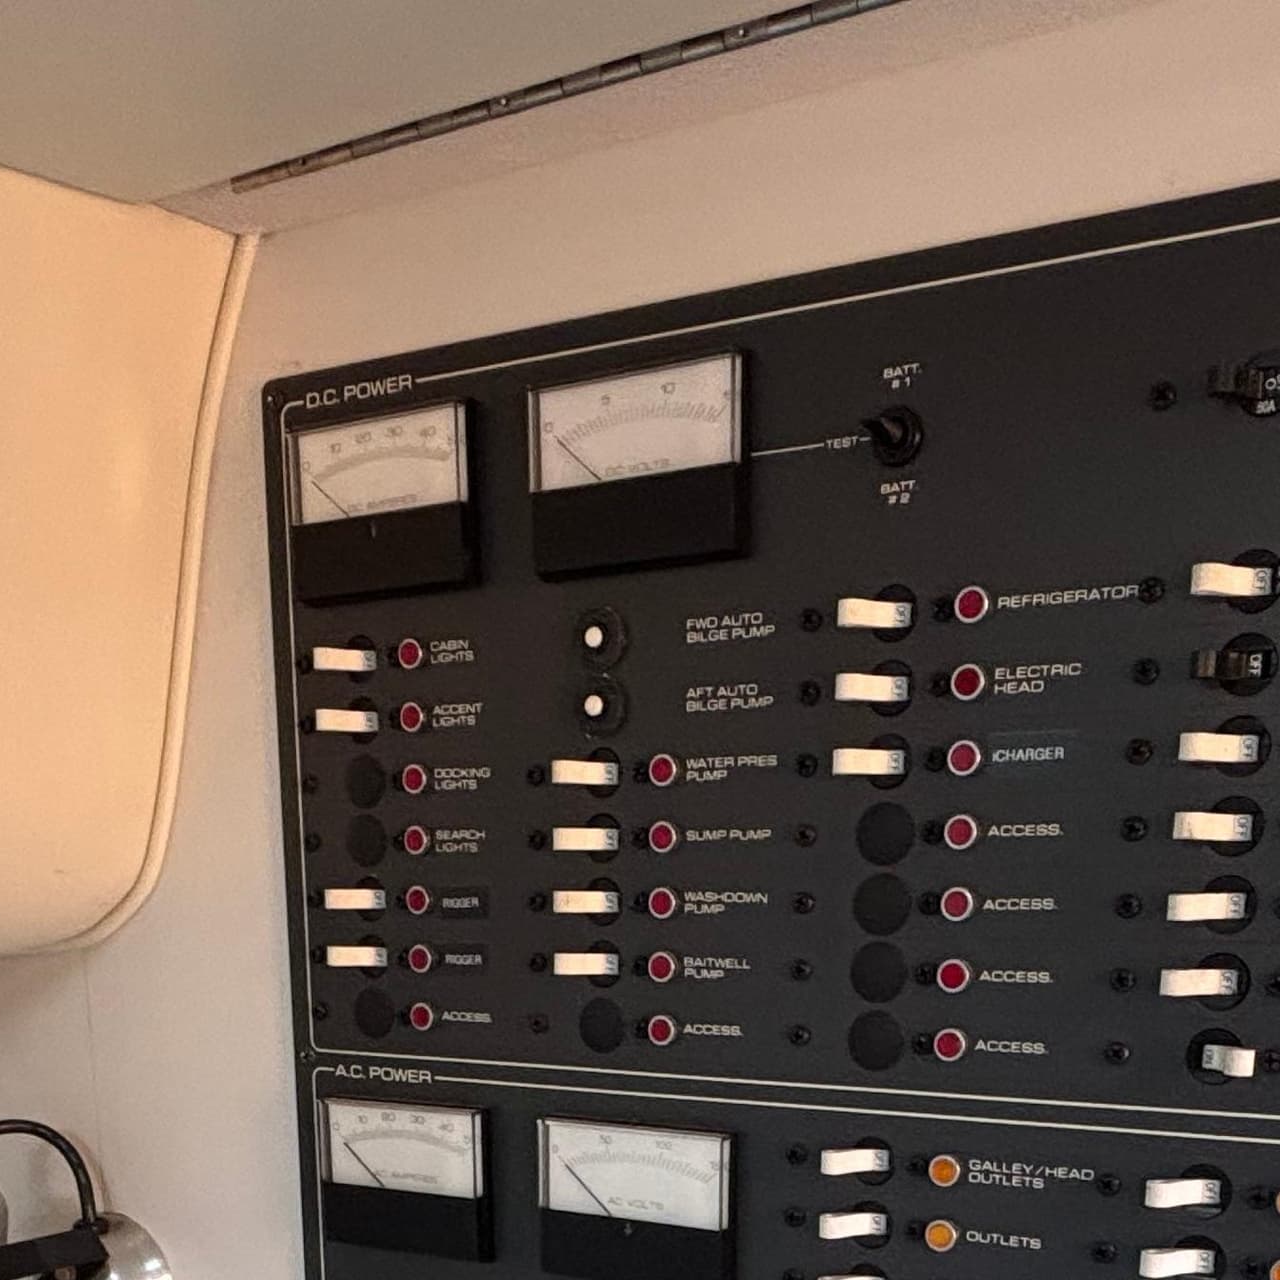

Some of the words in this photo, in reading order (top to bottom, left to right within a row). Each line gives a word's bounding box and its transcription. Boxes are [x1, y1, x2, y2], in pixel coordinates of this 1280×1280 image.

[306, 390, 340, 409] D.C.
[344, 374, 411, 401] POWER
[826, 436, 858, 448] TEST
[998, 585, 1138, 608] REFRIGERATOR
[686, 616, 718, 630] FWD
[721, 612, 763, 626] AUTO
[686, 629, 729, 643] BILGE
[732, 625, 775, 640] PUMP
[431, 640, 469, 651] CABIN
[431, 650, 474, 663] LIGHTS
[995, 663, 1081, 679] ELECTRIC
[686, 687, 714, 698] AFT
[717, 684, 758, 697] AUTO
[994, 680, 1044, 694] HEAD
[433, 703, 482, 715] ACCENT
[686, 699, 728, 712] BILGE
[731, 696, 774, 709] PUMP
[433, 714, 475, 727] LIGHTS
[686, 757, 734, 769] WATER
[738, 755, 777, 766] PRES
[434, 767, 490, 779] DOCKING
[686, 770, 727, 781] PUMP
[435, 777, 477, 790] LIGHTS
[436, 830, 485, 841] SEARCH
[686, 830, 727, 841] SUMP
[730, 829, 771, 840] PUMP
[988, 824, 1063, 836] ACCESS.
[436, 842, 478, 852] LIGHTS
[443, 897, 479, 908] RIGGER
[684, 892, 768, 904] WASHDOWN
[983, 898, 1057, 910] ACCESS.
[684, 903, 725, 914] PUMP
[445, 954, 482, 965] RIGGER
[684, 957, 750, 969] BAITWELL
[684, 968, 725, 978] PUMP
[980, 971, 1053, 983] ACCESS.
[442, 1011, 491, 1023] ACCESS.
[684, 1024, 743, 1036] ACCESS.
[975, 1040, 1048, 1054] ACCESS.
[334, 1064, 365, 1078] A.C.
[369, 1067, 431, 1083] POWER
[969, 1160, 1094, 1182] GALLEY/HEAD
[969, 1172, 1044, 1189] OUTLETS
[966, 1231, 1041, 1249] OUTLETS
